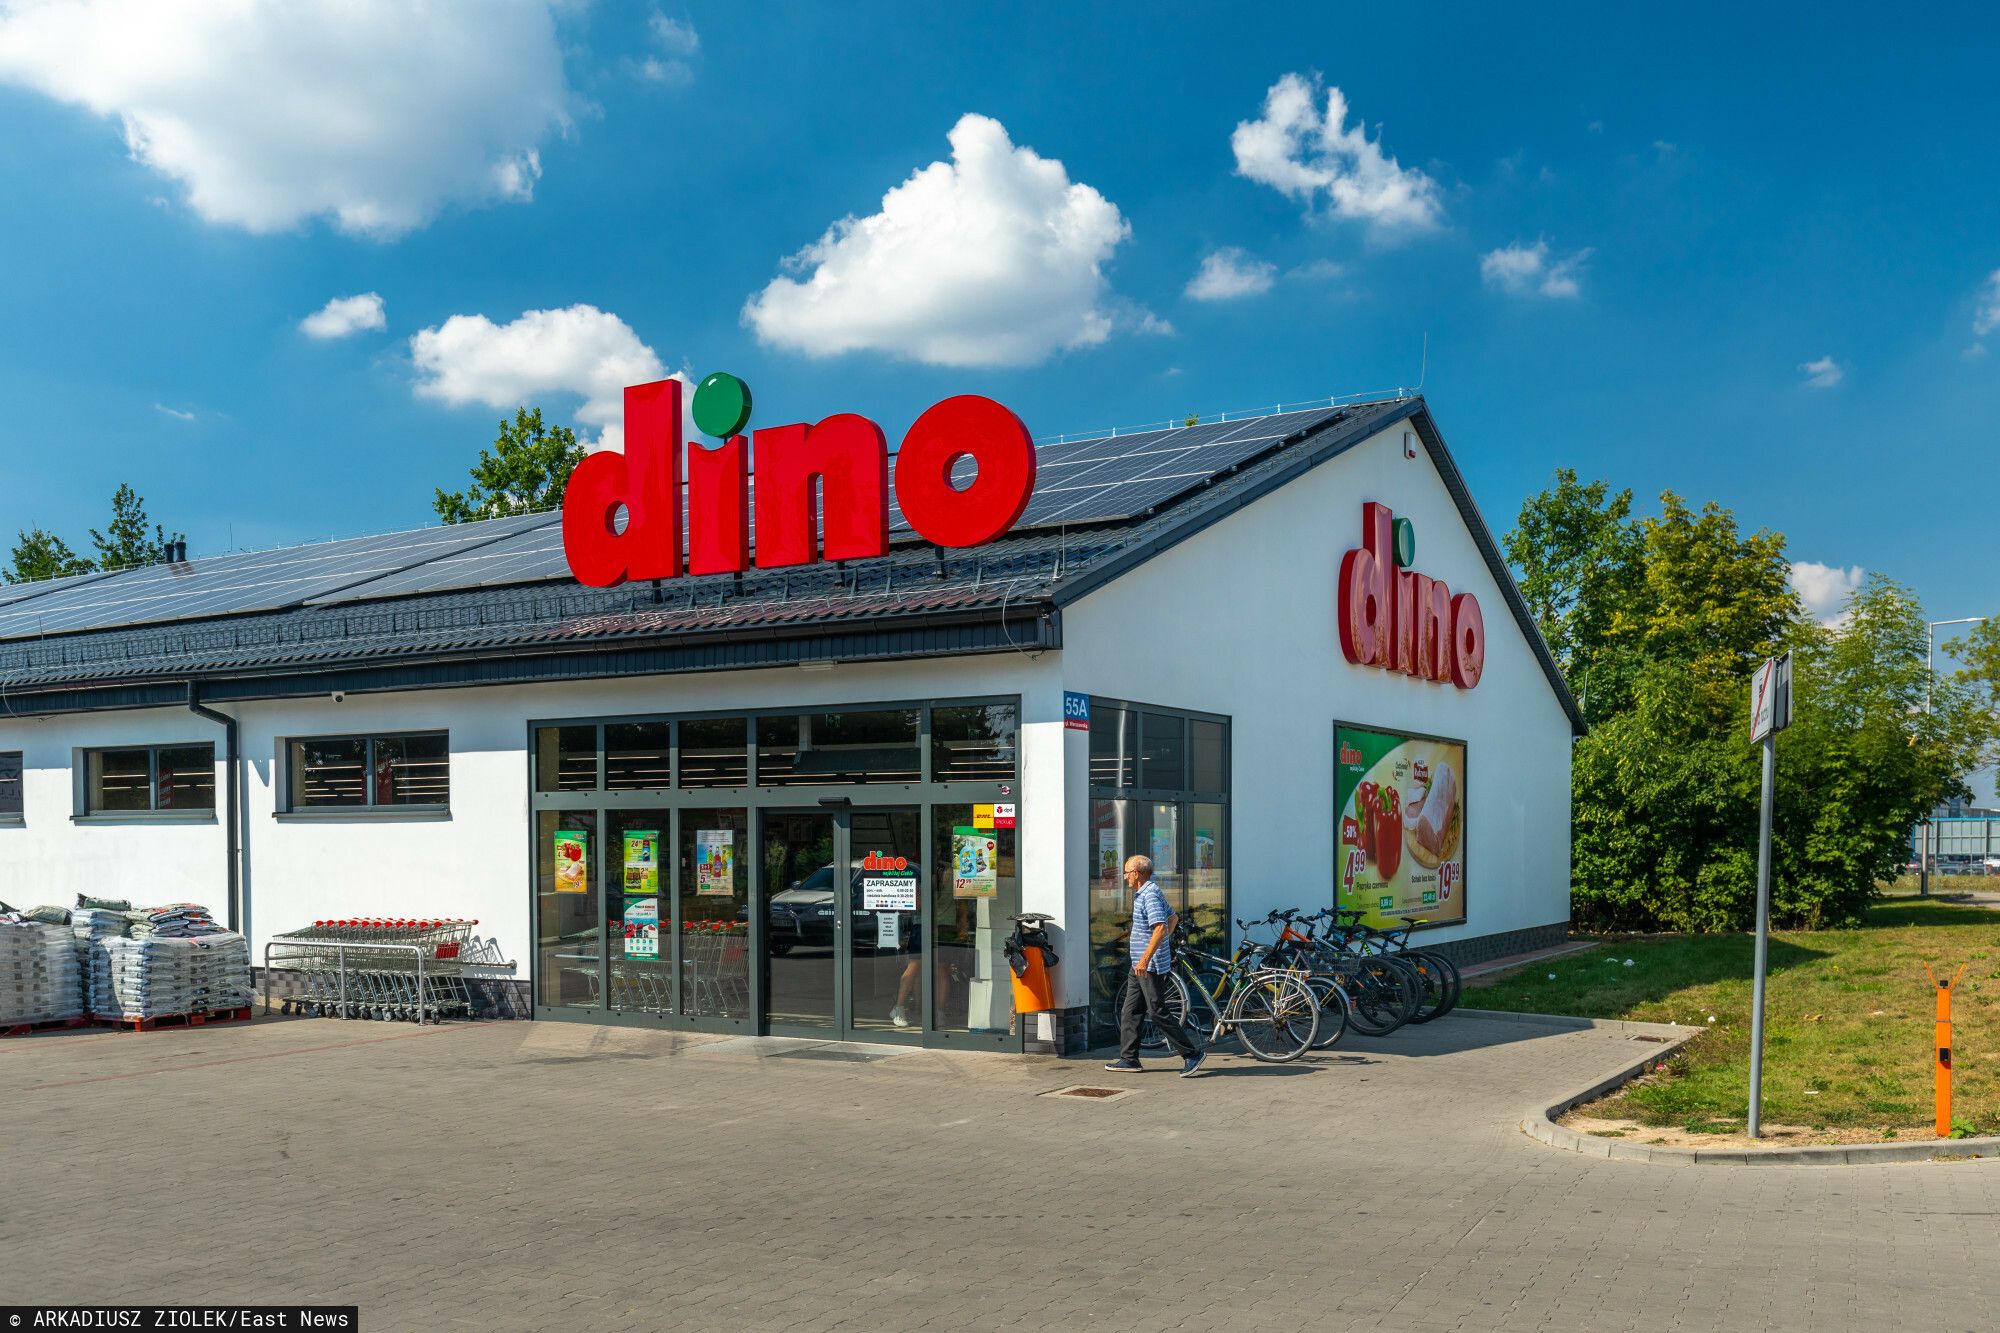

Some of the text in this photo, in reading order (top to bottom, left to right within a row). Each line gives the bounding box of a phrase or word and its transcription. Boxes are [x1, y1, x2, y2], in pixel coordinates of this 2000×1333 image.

[562, 371, 1037, 588] dino
[1337, 501, 1485, 690] dino
[1066, 697, 1088, 716] 55A
[864, 850, 907, 870] dino
